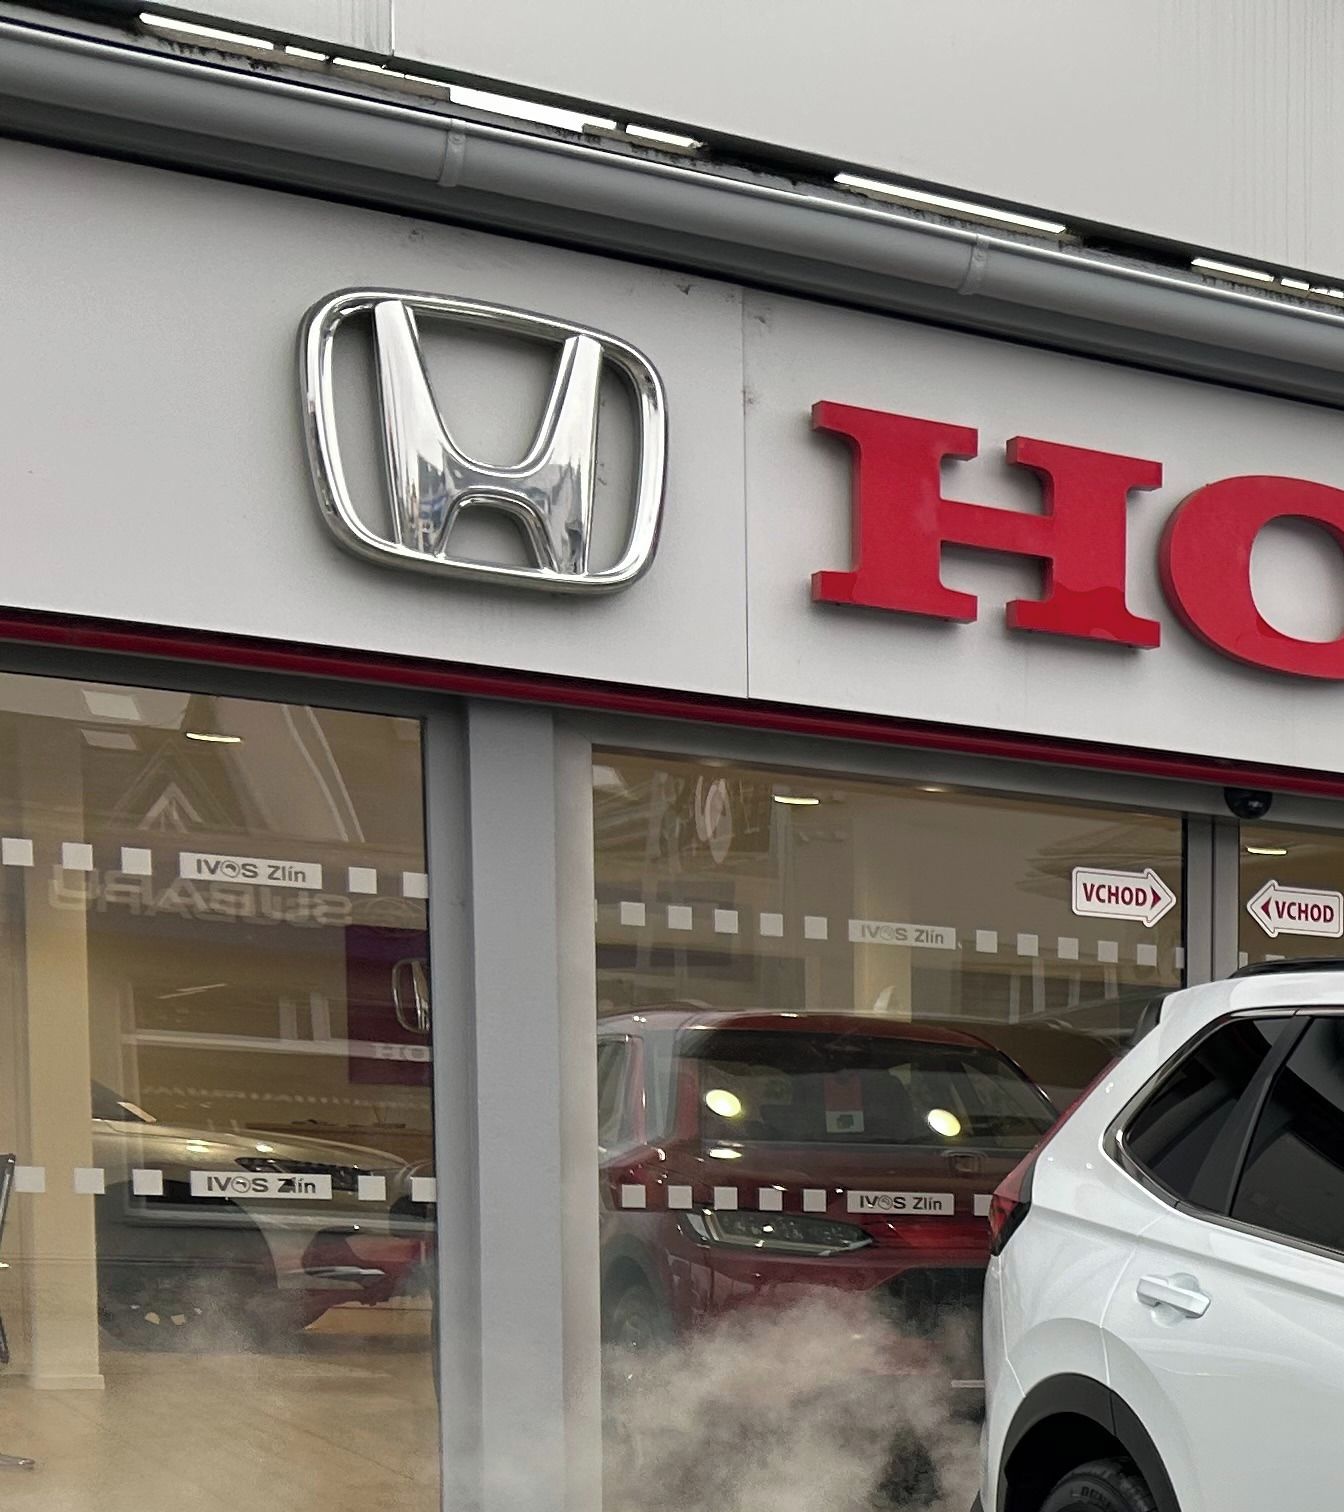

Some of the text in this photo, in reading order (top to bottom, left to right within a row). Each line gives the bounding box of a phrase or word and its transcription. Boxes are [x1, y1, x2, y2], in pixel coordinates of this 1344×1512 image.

[267, 864, 306, 883] Zlín
[1082, 882, 1148, 907] VCHOD
[1275, 900, 1334, 924] VCHOD
